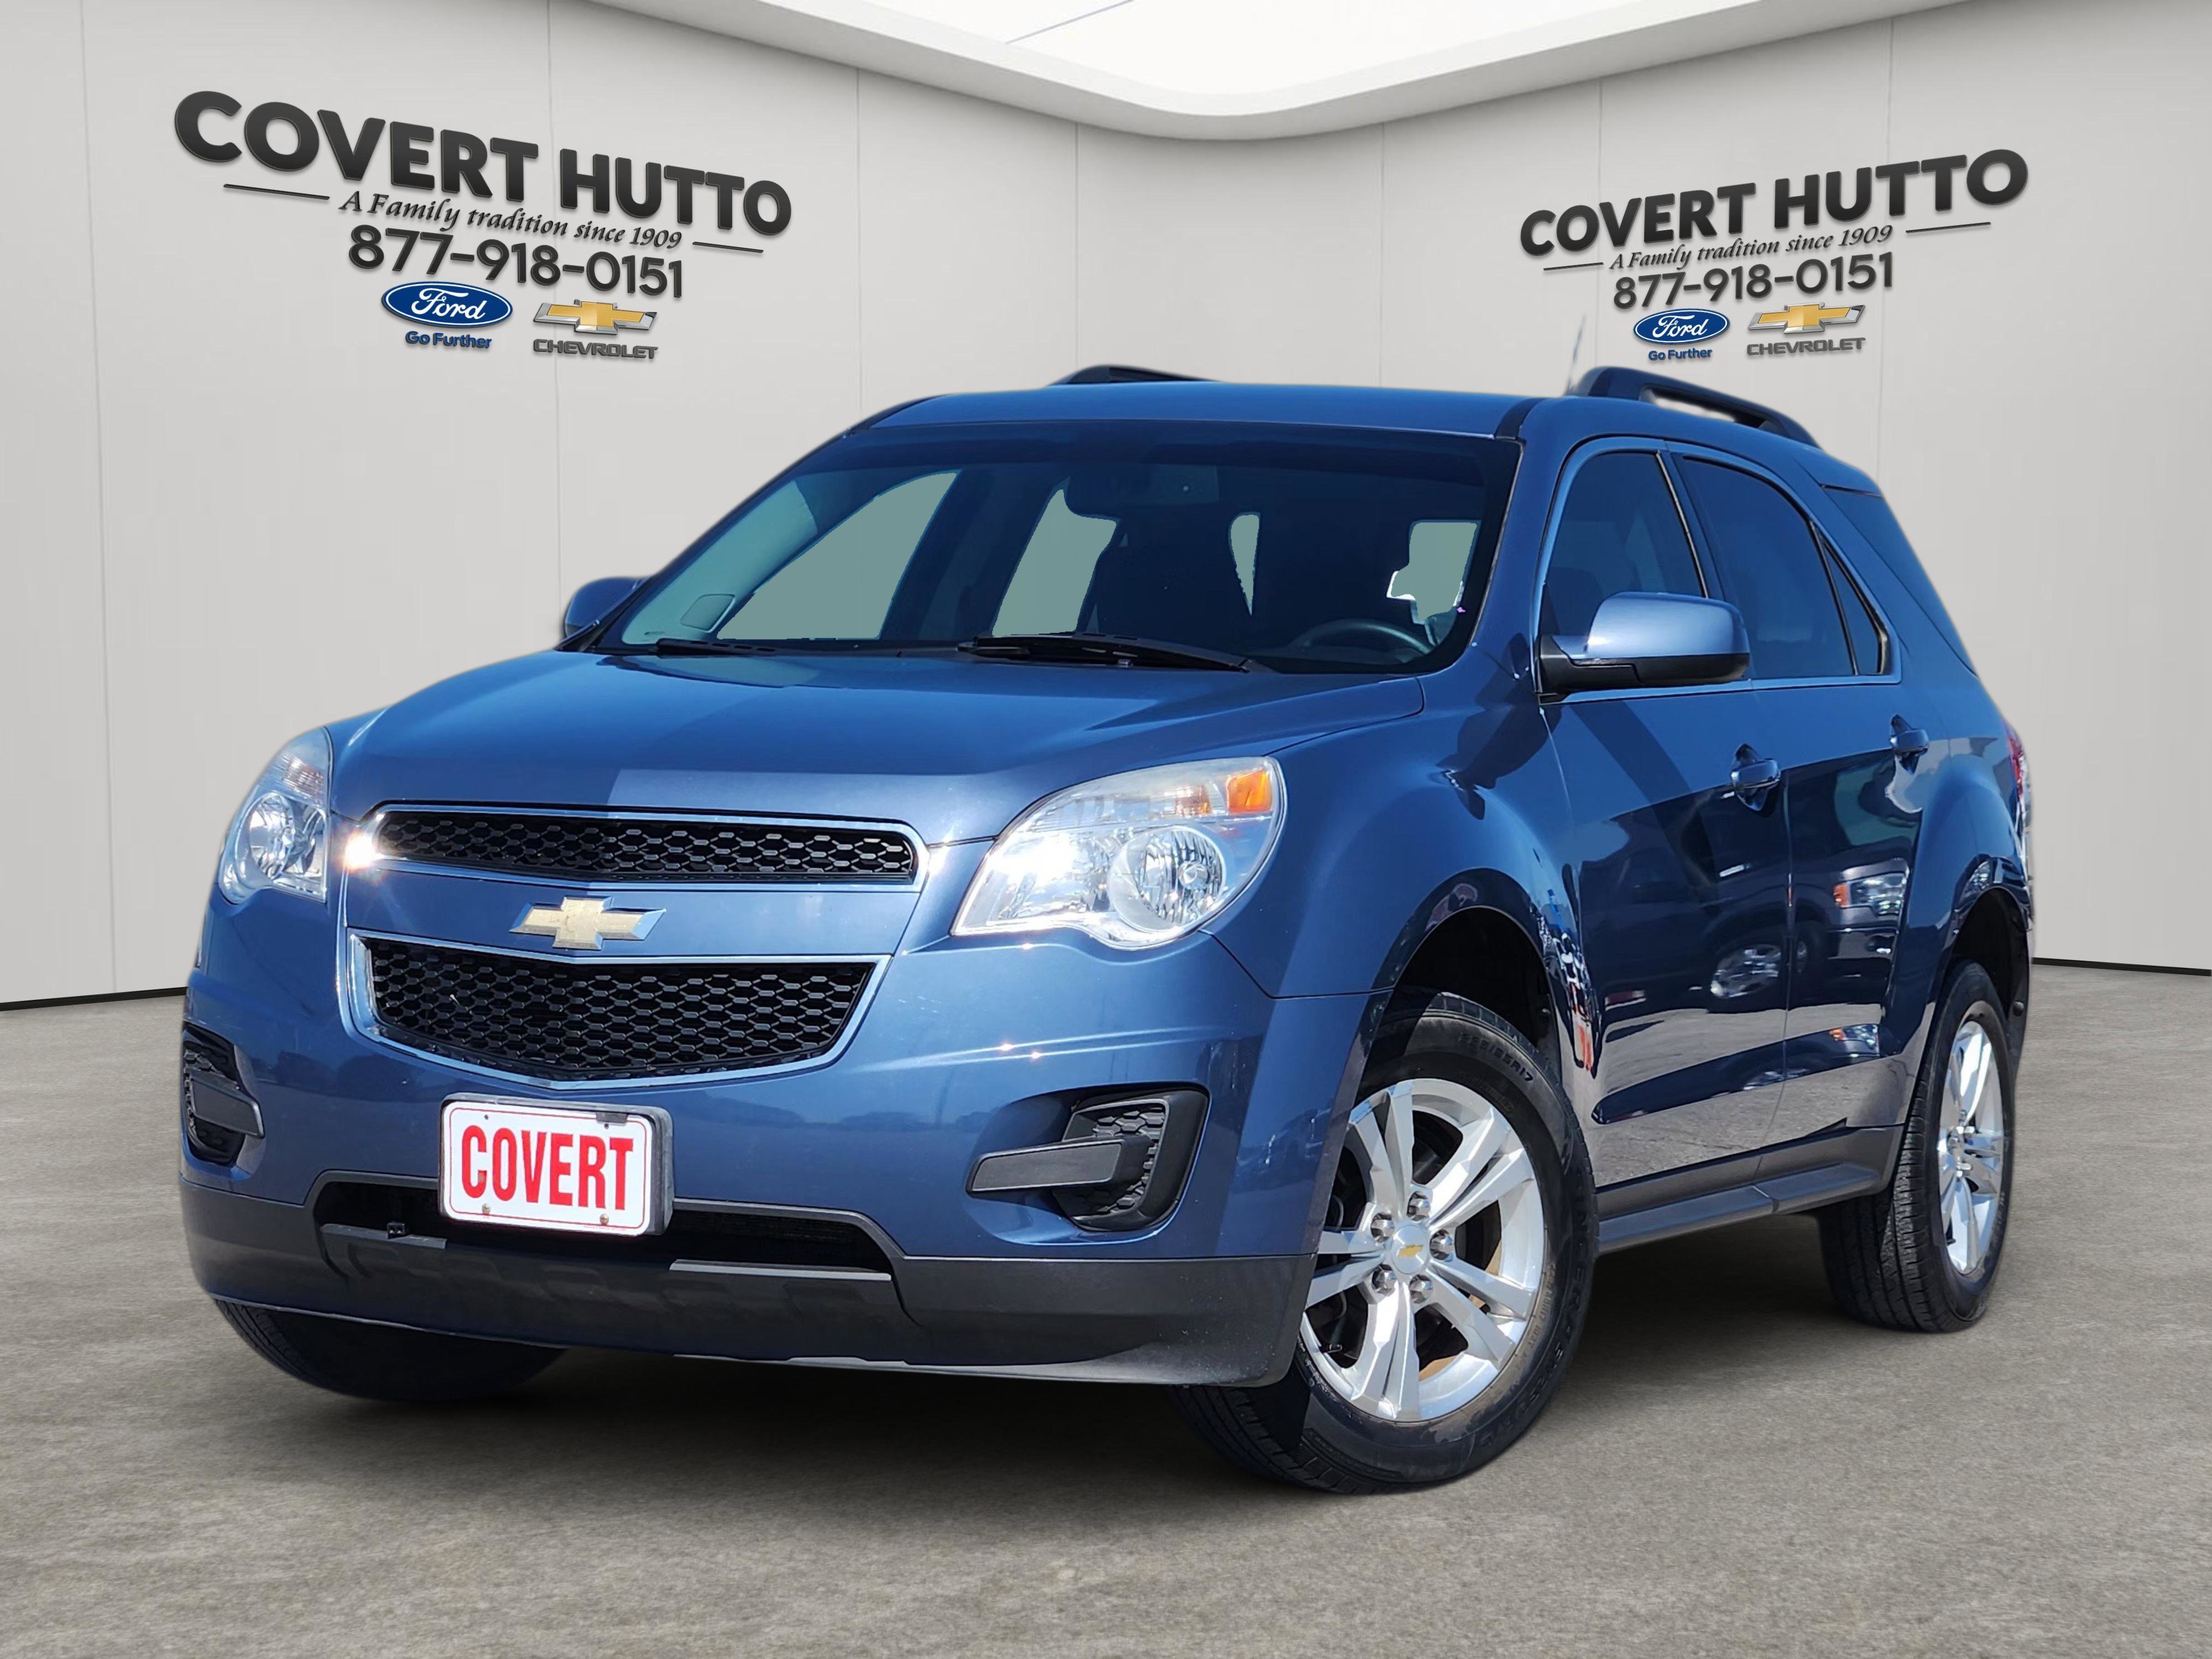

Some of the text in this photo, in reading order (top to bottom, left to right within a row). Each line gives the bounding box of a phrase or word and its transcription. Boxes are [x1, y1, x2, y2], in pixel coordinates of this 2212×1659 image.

[175, 91, 791, 236] COVERT HUTTO
[338, 190, 682, 249] A Family tradition since 1909
[1521, 149, 2028, 257] COVERT HUTTO
[348, 225, 682, 299] 877-918-0151
[1609, 225, 1893, 270] A Family tradition since 1909
[1613, 251, 1892, 310] 877-918-0151
[411, 288, 487, 321] Ford
[1651, 314, 1708, 338] Ford
[405, 331, 492, 349] Go Further
[534, 338, 658, 359] CHEVROLET
[1648, 348, 1713, 361] Go Further
[1746, 337, 1866, 356] CHEVROLET
[461, 1125, 634, 1211] COVERT
